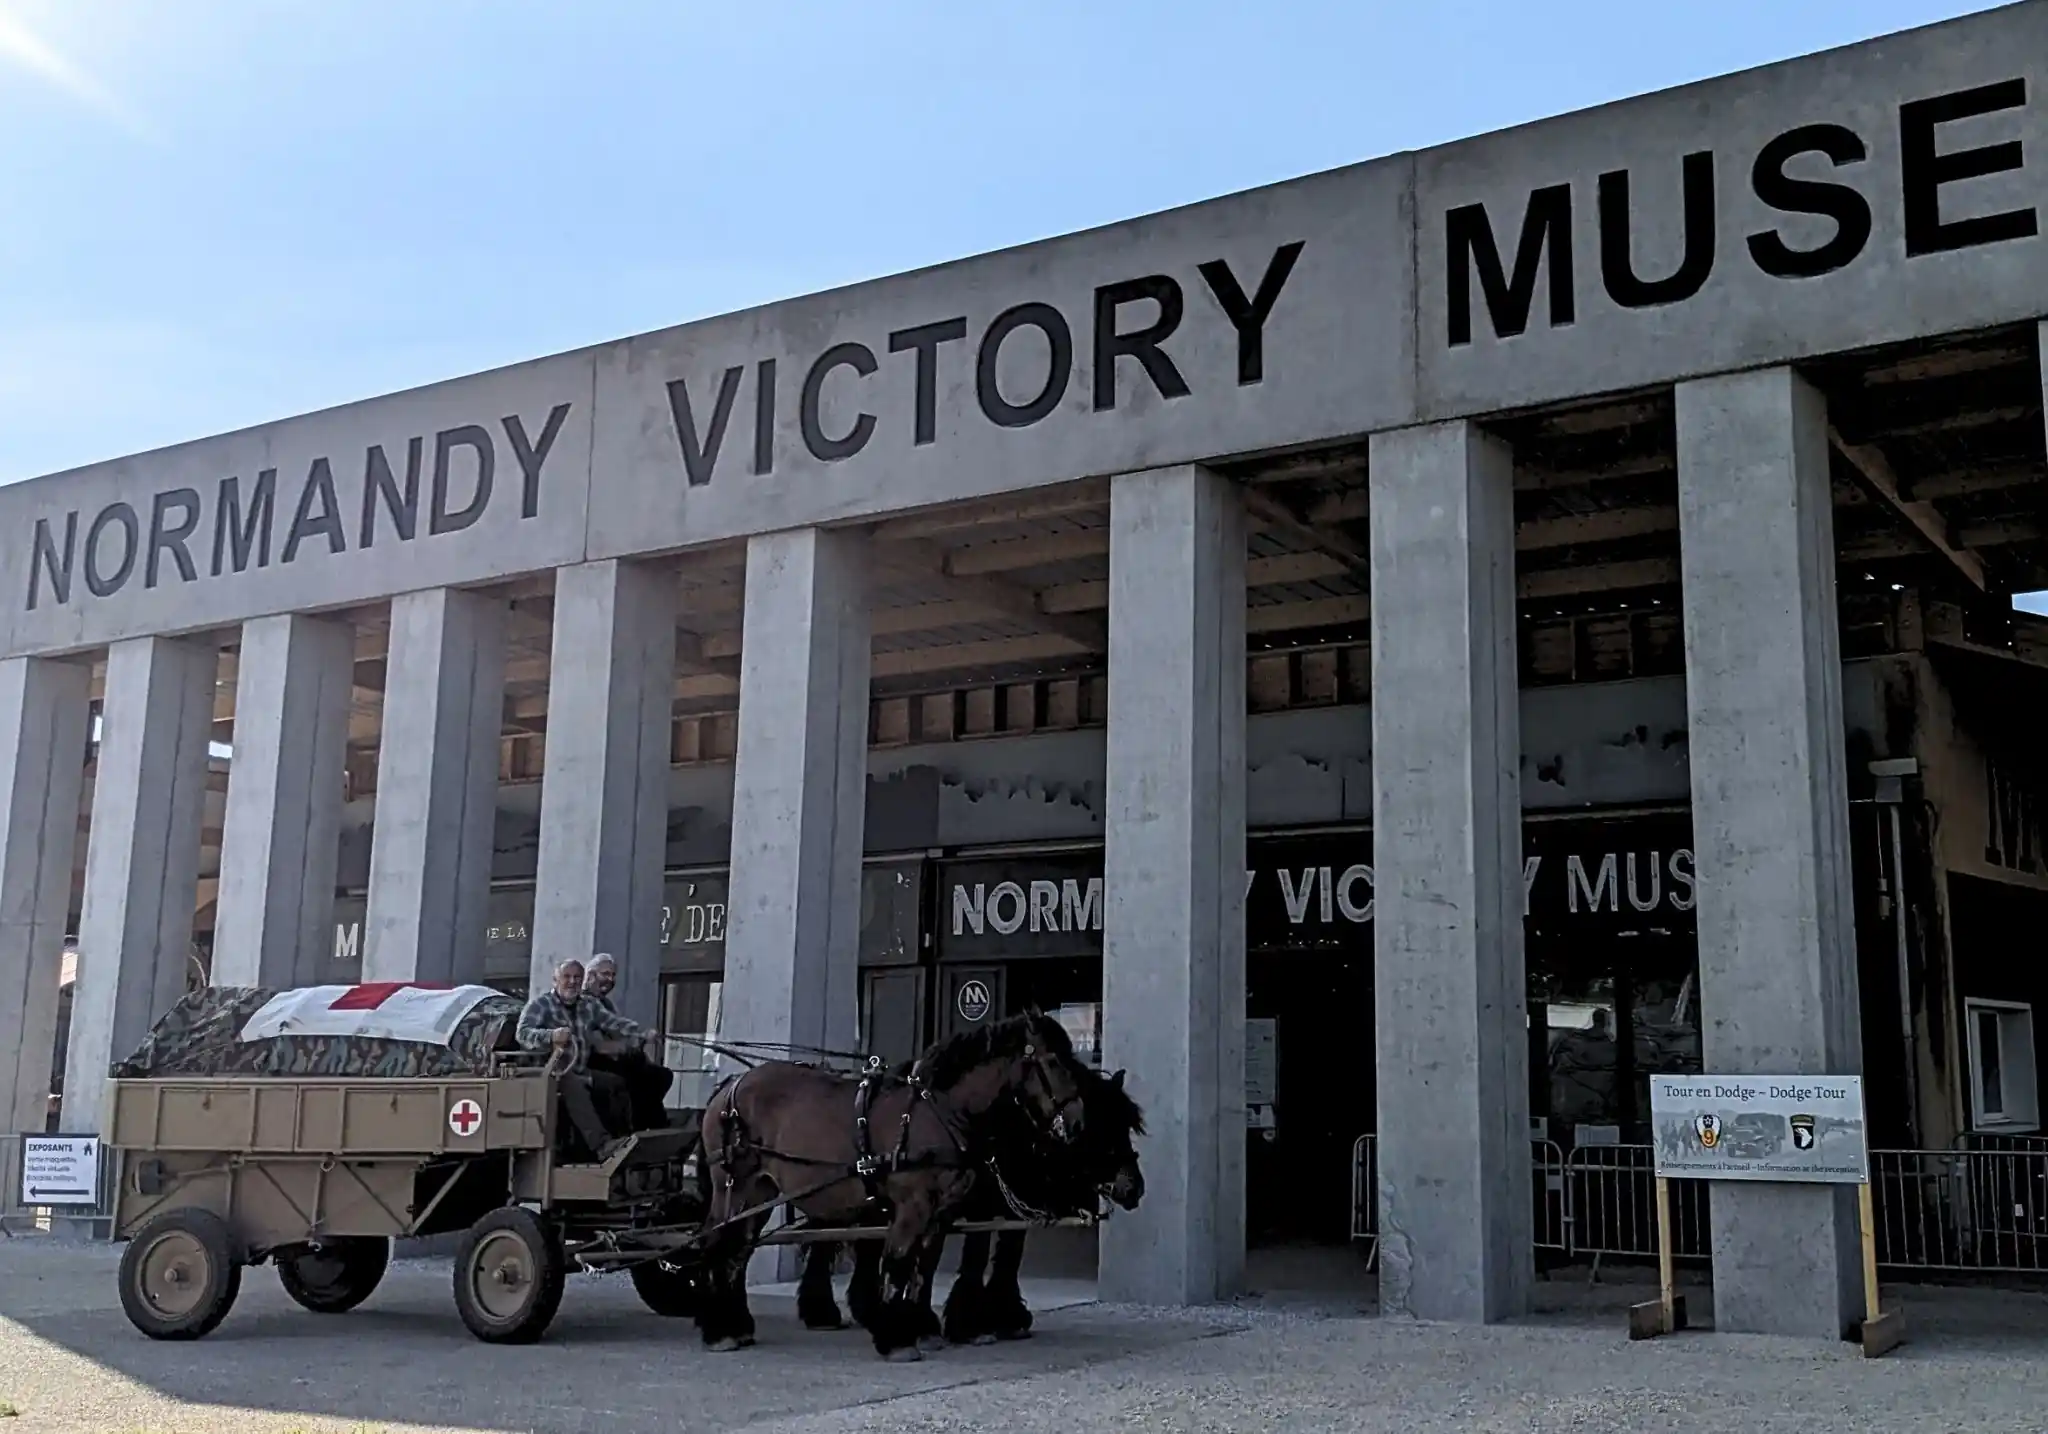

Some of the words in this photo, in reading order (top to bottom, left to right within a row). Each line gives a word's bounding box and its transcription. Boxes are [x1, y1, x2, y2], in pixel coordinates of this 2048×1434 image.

[25, 402, 572, 611] NORMANDY
[665, 240, 1306, 487] VICTORY
[1445, 77, 2039, 349] MUSE
[1664, 1085, 1693, 1097] Tour
[1696, 1086, 1711, 1097] en
[1715, 1085, 1756, 1101] Dodge
[1769, 1085, 1812, 1101] Dodge
[1813, 1086, 1846, 1099] Tour
[28, 1143, 73, 1152] EXPOSANTS
